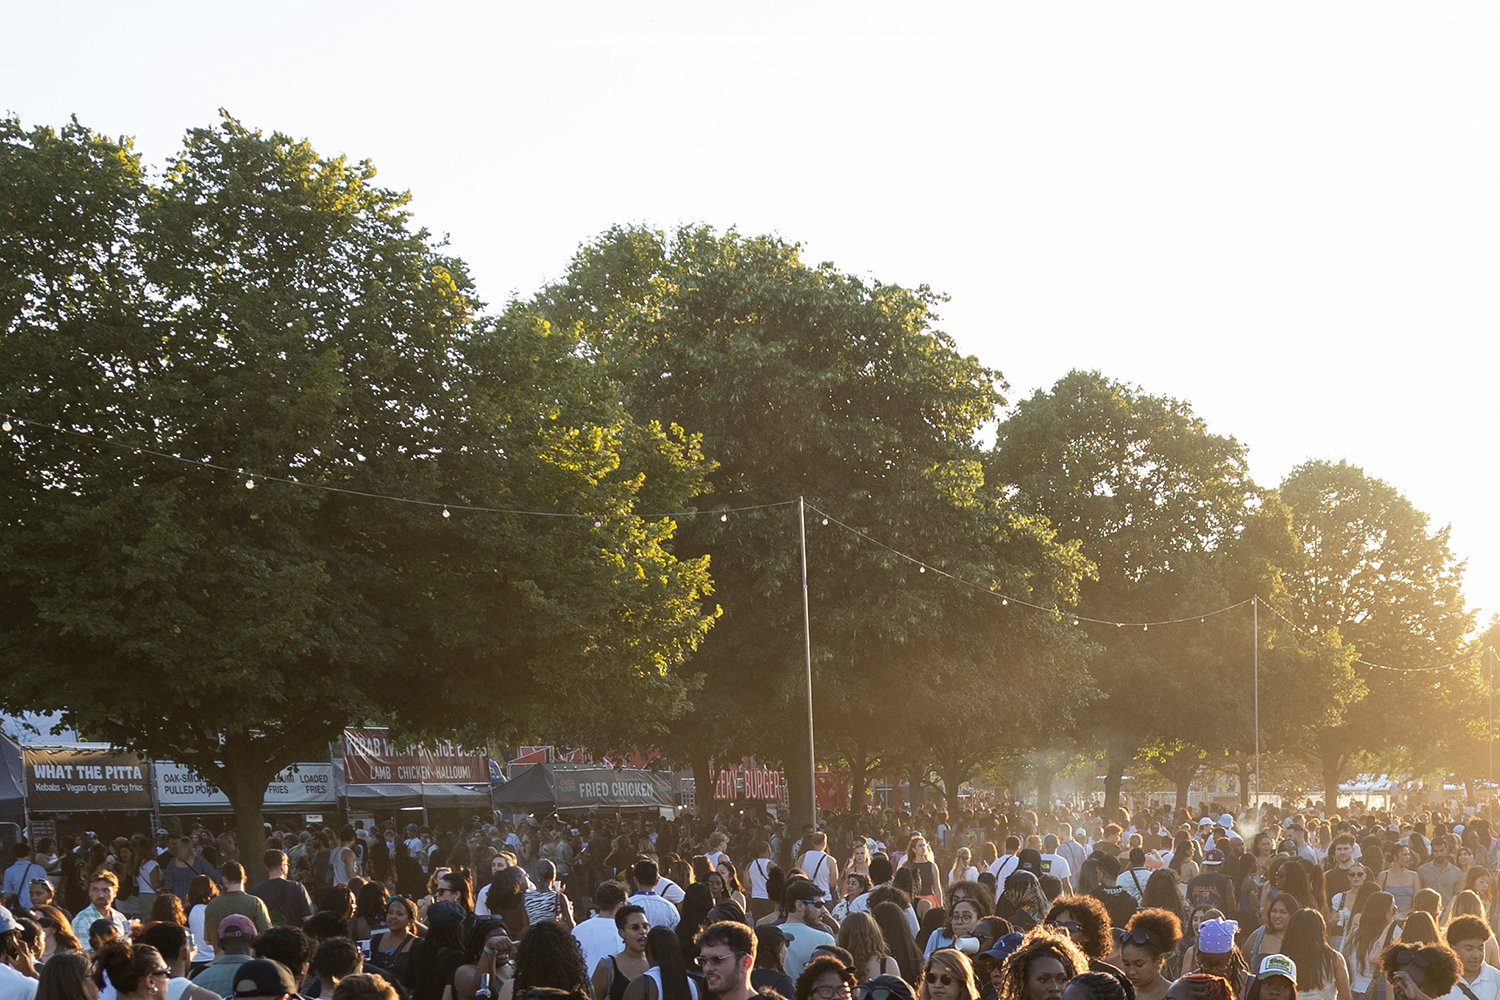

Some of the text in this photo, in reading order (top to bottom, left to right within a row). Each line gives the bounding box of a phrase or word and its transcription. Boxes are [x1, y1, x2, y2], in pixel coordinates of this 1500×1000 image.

[346, 737, 381, 757] KEBAB
[383, 738, 424, 757] WPS
[33, 764, 143, 780] WHAT THE PITTA
[300, 774, 329, 783] LOADED
[370, 765, 471, 780] LAMB CHICKEN HALLOUMI
[35, 783, 61, 792] Kebabs
[65, 783, 87, 794] Vegan
[87, 783, 107, 794] Gyros
[112, 783, 129, 794] Dirty
[129, 783, 144, 792] fries
[164, 785, 194, 795] PULLED
[268, 785, 289, 794] FRIES
[305, 785, 327, 794] FRIES
[579, 782, 609, 798] FRIED
[611, 781, 654, 798] CHICKEN
[744, 769, 780, 799] BURGER
